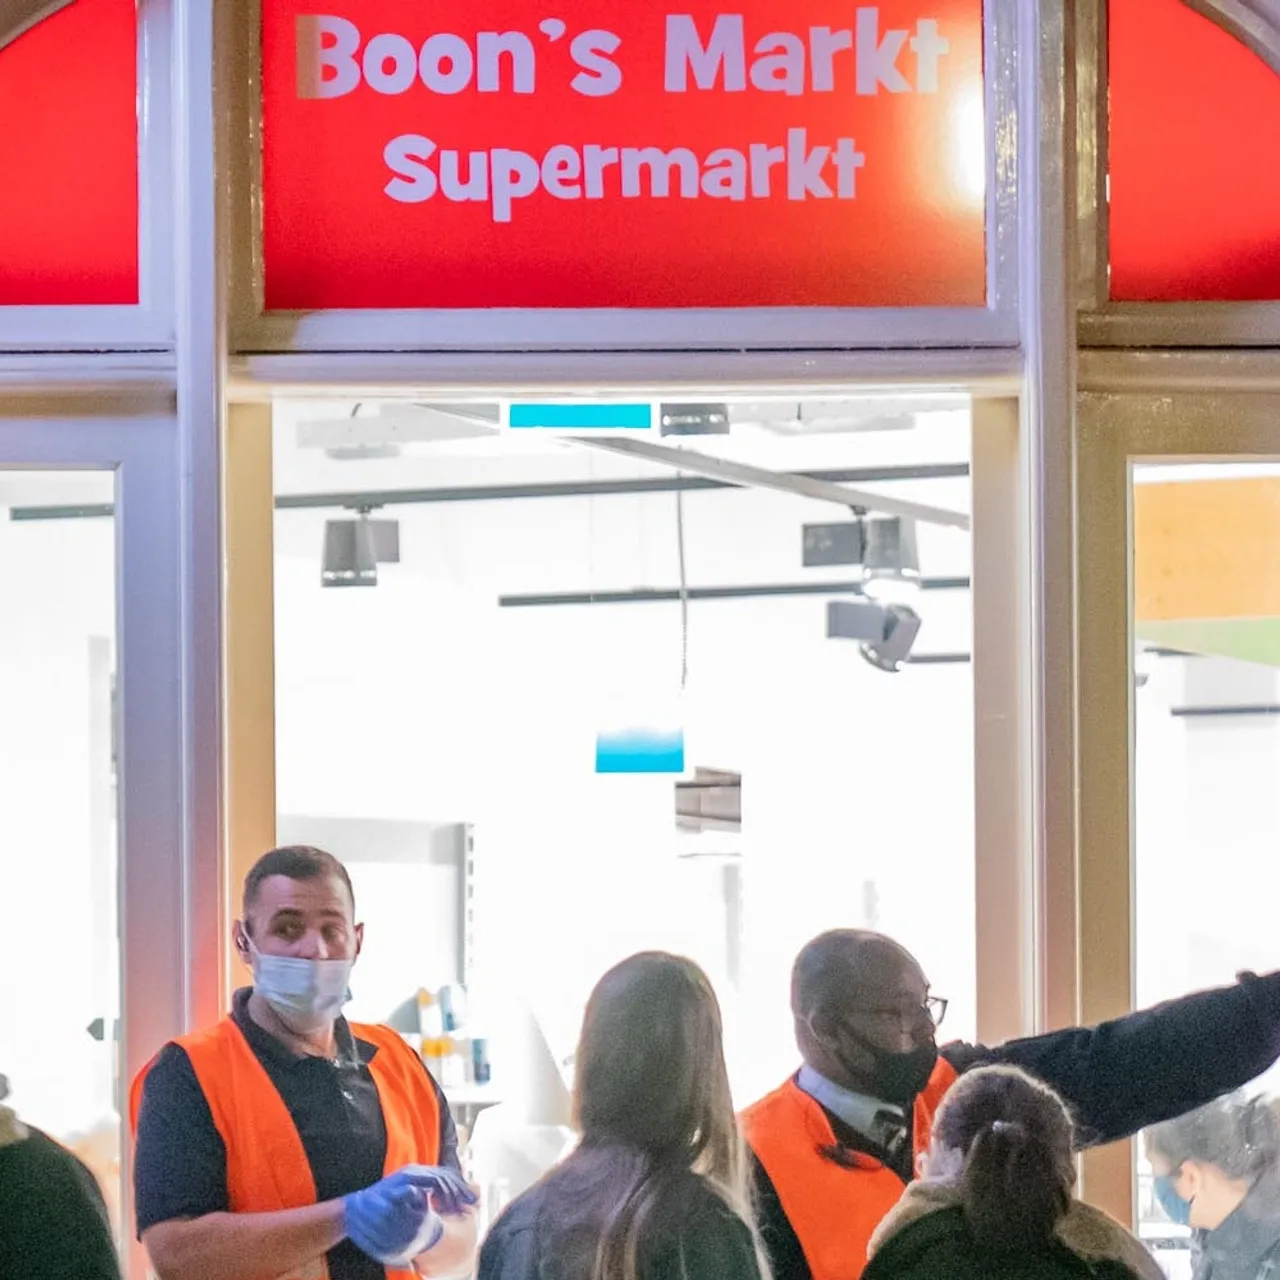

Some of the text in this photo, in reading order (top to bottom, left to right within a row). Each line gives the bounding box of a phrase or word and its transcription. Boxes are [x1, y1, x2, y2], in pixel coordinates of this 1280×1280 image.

[296, 7, 950, 99] Boon's Markt
[383, 128, 866, 222] Supermarkt
